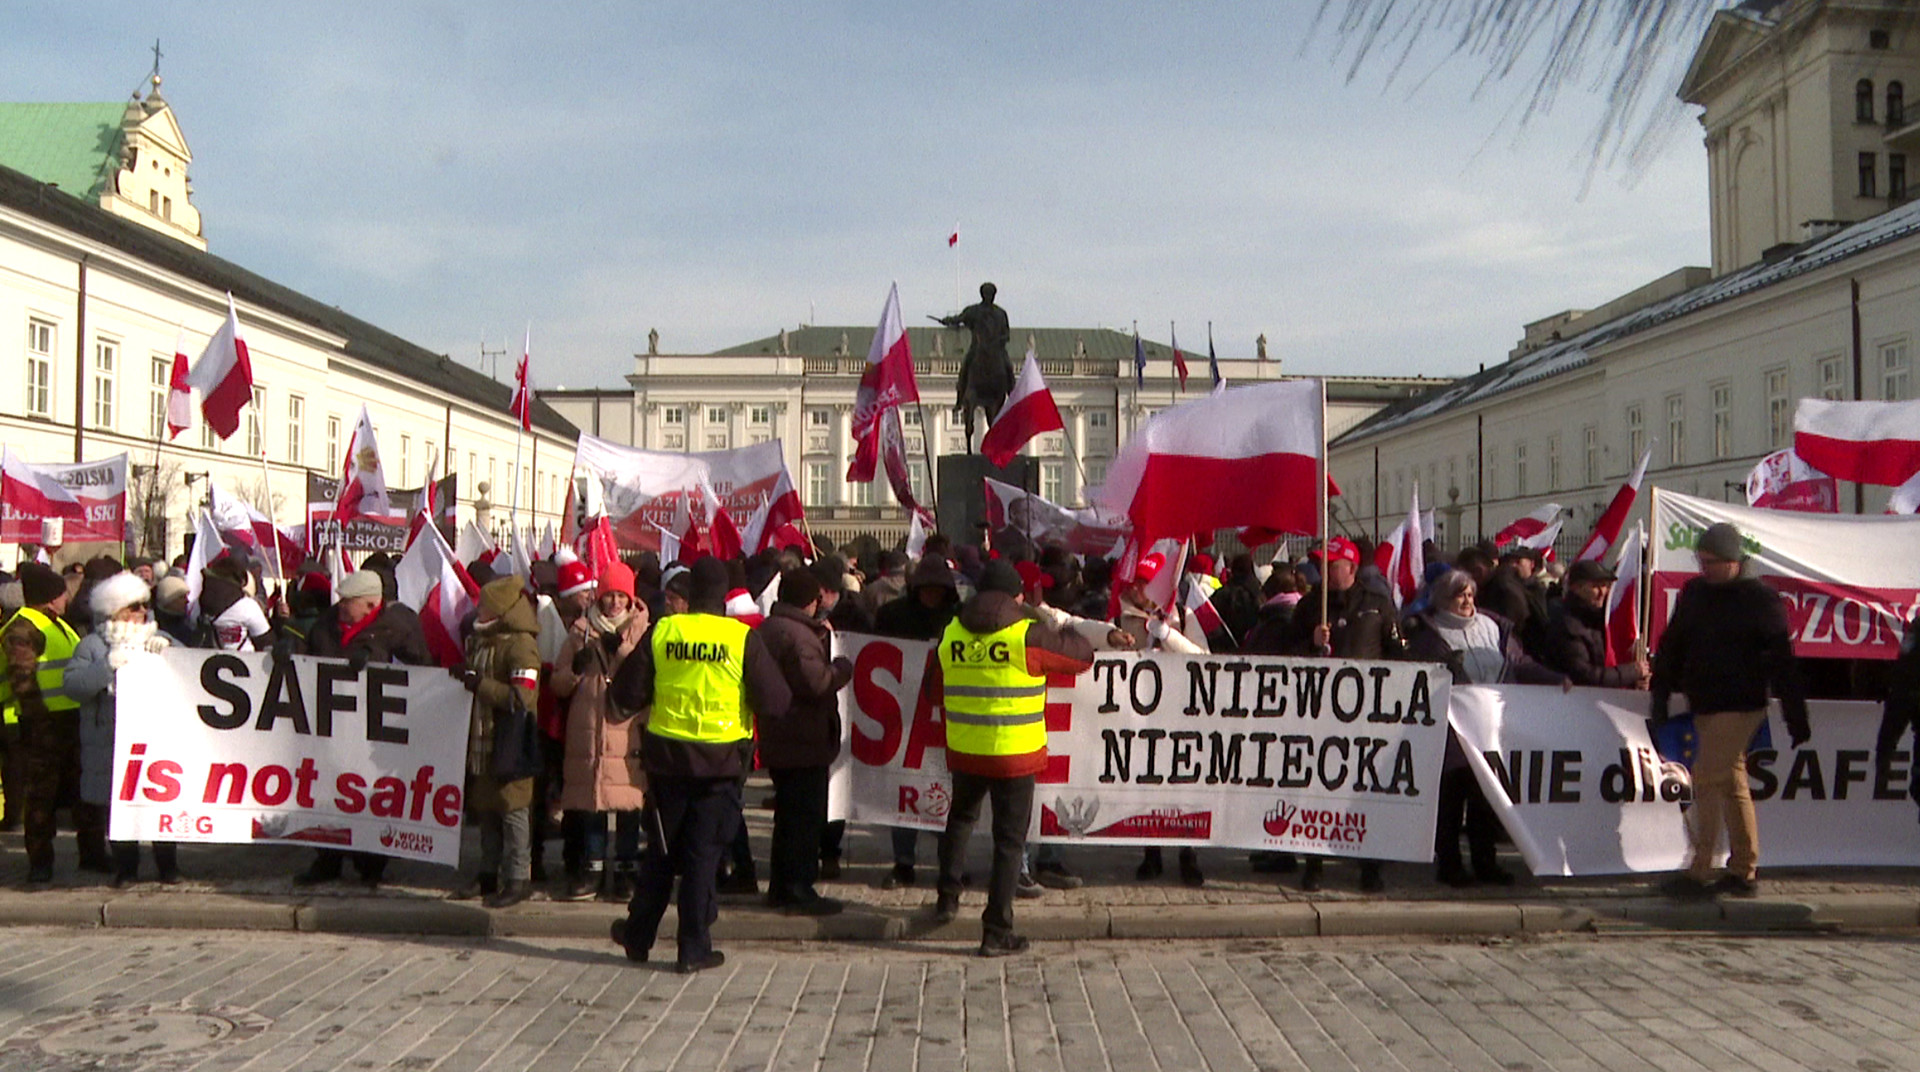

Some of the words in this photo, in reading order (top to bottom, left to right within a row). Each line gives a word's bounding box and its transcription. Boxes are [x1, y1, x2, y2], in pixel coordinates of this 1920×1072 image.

[666, 641, 727, 662] POLICJA
[197, 653, 409, 745] SAFE
[851, 640, 1077, 784] SAE
[1094, 659, 1163, 715] TO
[1183, 661, 1436, 726] NIEWOLA
[119, 743, 184, 803] is
[202, 758, 319, 807] not
[333, 765, 462, 828] safe
[1098, 728, 1420, 796] NIEMIECKA
[1484, 750, 1582, 804] NIE
[1747, 749, 1910, 802] SAFE
[1292, 824, 1367, 842] POLACY
[1301, 809, 1366, 828] WOLNI
